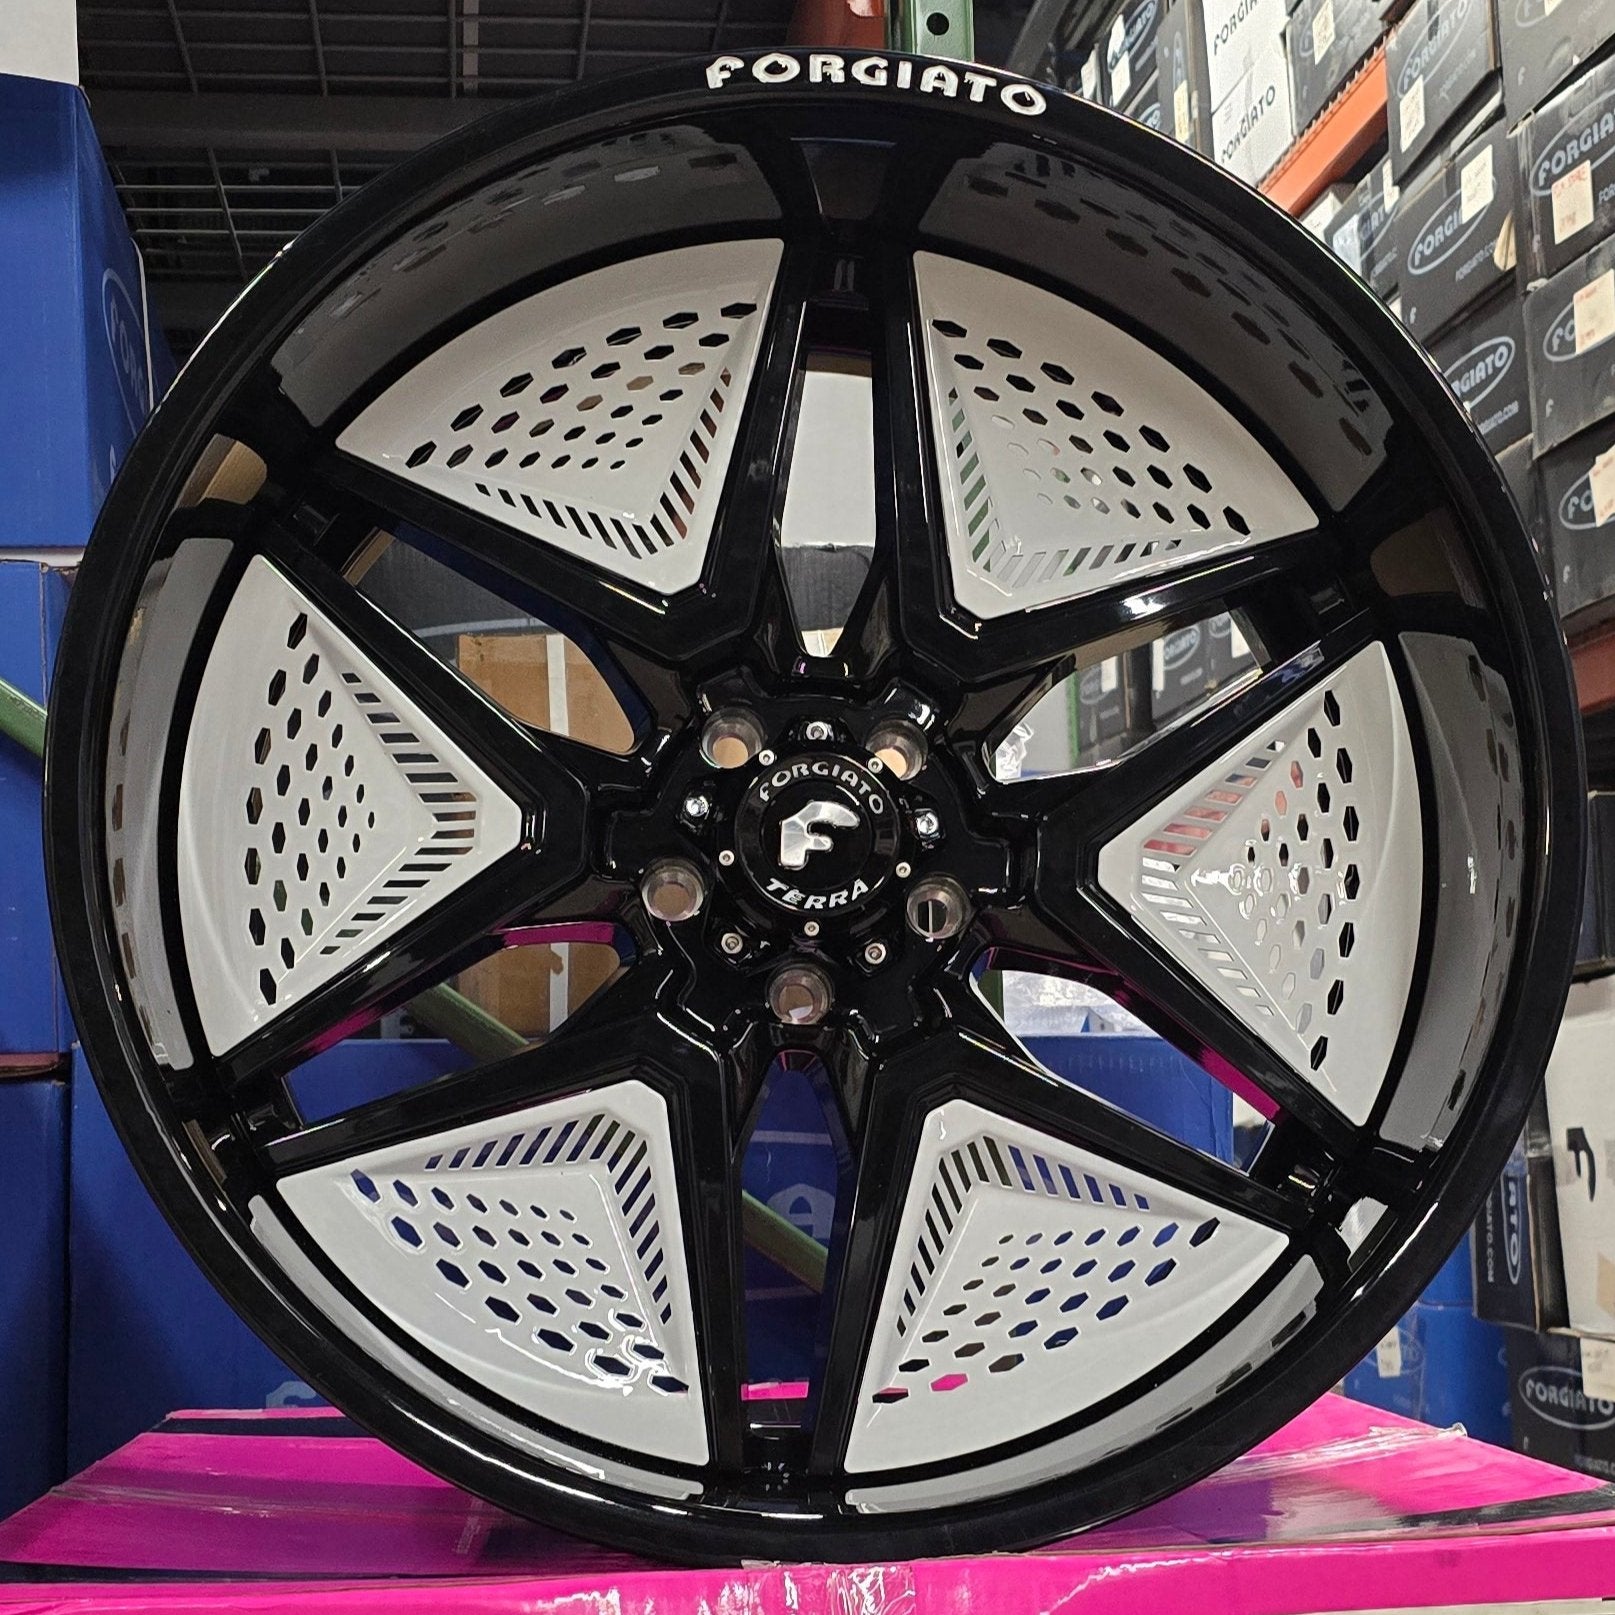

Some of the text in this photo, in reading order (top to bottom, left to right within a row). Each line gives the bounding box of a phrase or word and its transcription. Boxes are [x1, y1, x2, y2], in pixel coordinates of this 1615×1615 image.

[1213, 0, 1260, 56] FORGIA
[705, 53, 1047, 116] FORGIATO
[1220, 85, 1276, 164] FORGIATO
[1538, 108, 1615, 187] FORGIA
[1413, 205, 1463, 267] FORGI
[1450, 345, 1509, 398] RGIATO
[759, 761, 884, 814] FORGIATO
[779, 800, 861, 871] F
[766, 877, 869, 909] TERRA
